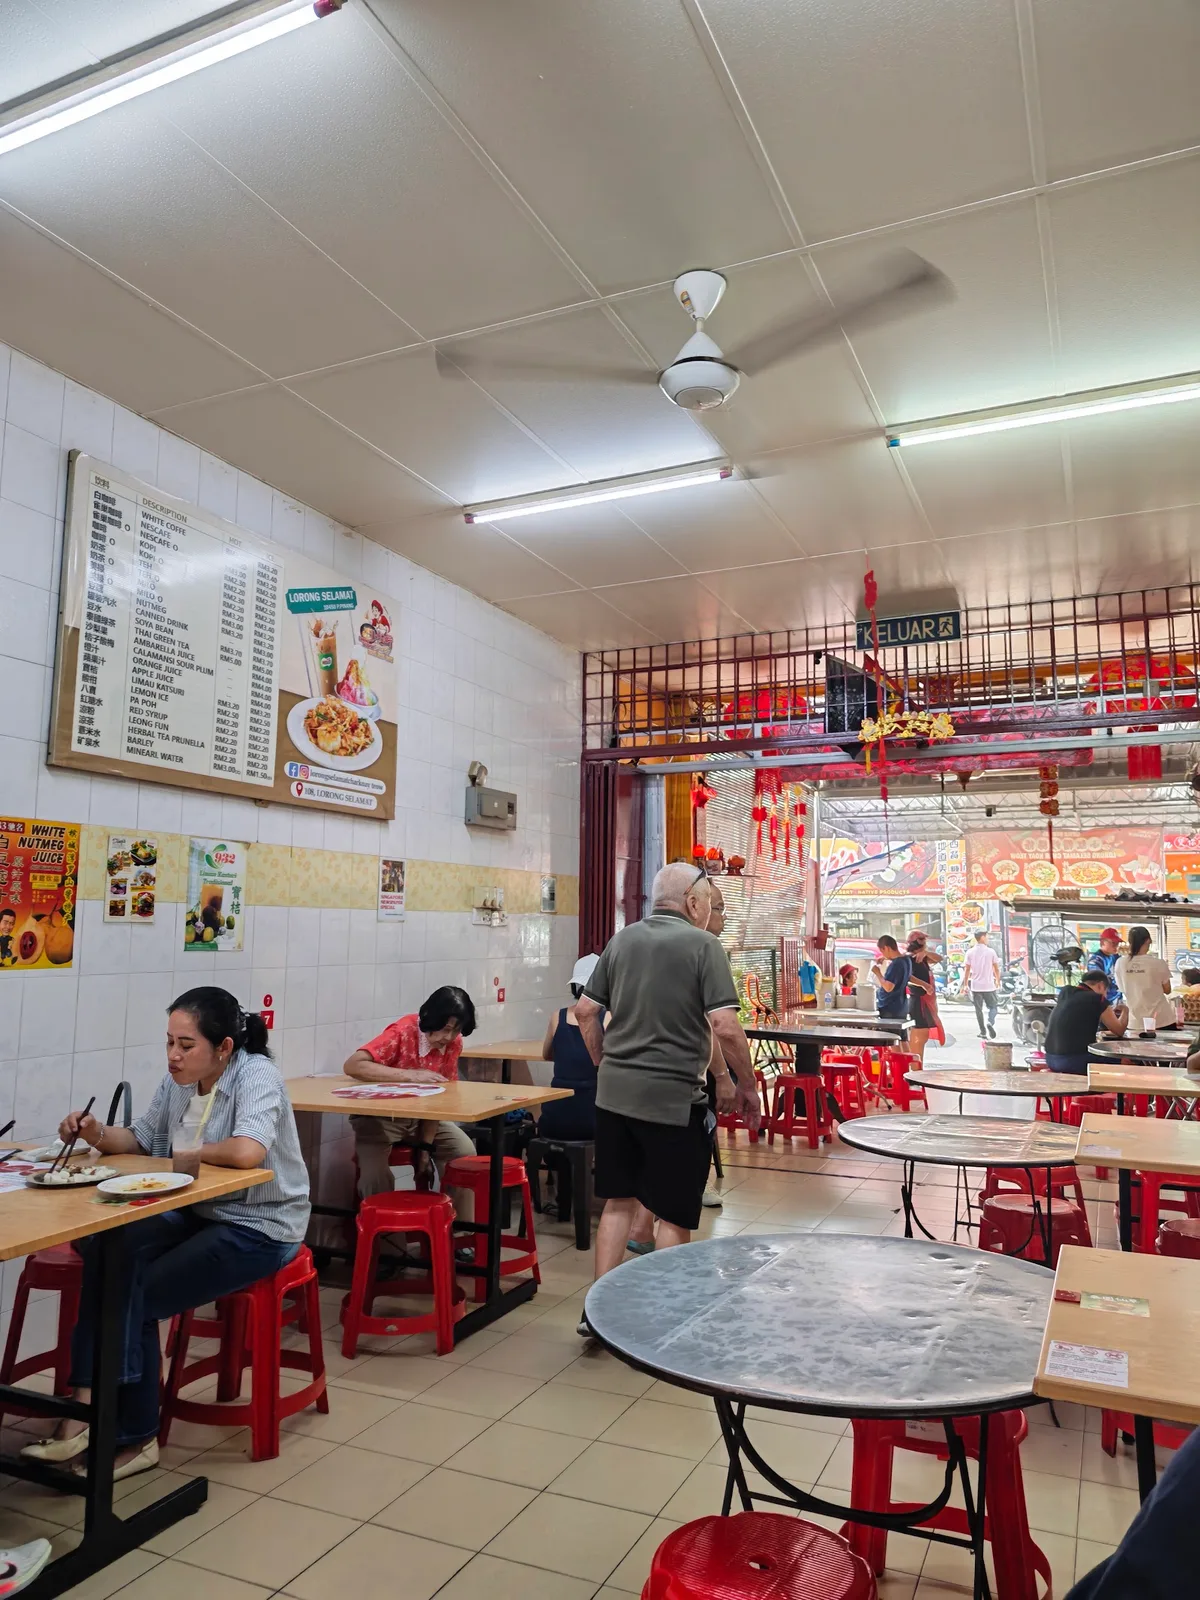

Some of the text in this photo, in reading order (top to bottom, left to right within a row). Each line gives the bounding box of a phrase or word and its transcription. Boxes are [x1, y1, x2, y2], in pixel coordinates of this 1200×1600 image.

[143, 498, 187, 523] DESCRIPTION
[141, 521, 171, 539] NESCAFE
[142, 511, 186, 536] WHITE COFFE
[140, 530, 170, 548] NESCAFE
[140, 540, 156, 552] KOPI
[139, 550, 155, 561] KOPI
[139, 559, 152, 570] TEH
[137, 588, 155, 599] MILO
[289, 591, 353, 602] LORONG SELAMAT
[136, 598, 167, 614] NUTMEG
[135, 618, 173, 635] SOYA BEAN
[136, 608, 188, 631] CANNED DRINK
[134, 627, 189, 650] THAI GREEN TEA
[864, 619, 935, 645] KELUAR
[134, 637, 195, 661] AMBARELLA JUICE
[133, 647, 214, 676] CALAMANSI SOUR PLUM
[133, 657, 182, 676] ORANGE JUICE
[132, 667, 174, 684] APPLE JUICE
[131, 686, 169, 702] LEMON ICE
[132, 676, 185, 696] LIMAU KATSURI
[130, 696, 156, 708] PA POH
[129, 706, 168, 720] RED SYRUP
[129, 716, 169, 731] LEONG FUN
[127, 736, 154, 747] BARLEY
[128, 726, 205, 748] HERBAL TEA PRUNELLA
[126, 746, 183, 763] MINEARL WATER
[305, 788, 373, 806] 108, LORONG SELAMAT
[32, 825, 66, 838] WHITE
[18, 837, 64, 850] NUTMEG
[33, 852, 64, 863] JUICE
[215, 853, 235, 864] 932
[265, 1015, 270, 1025] 7
